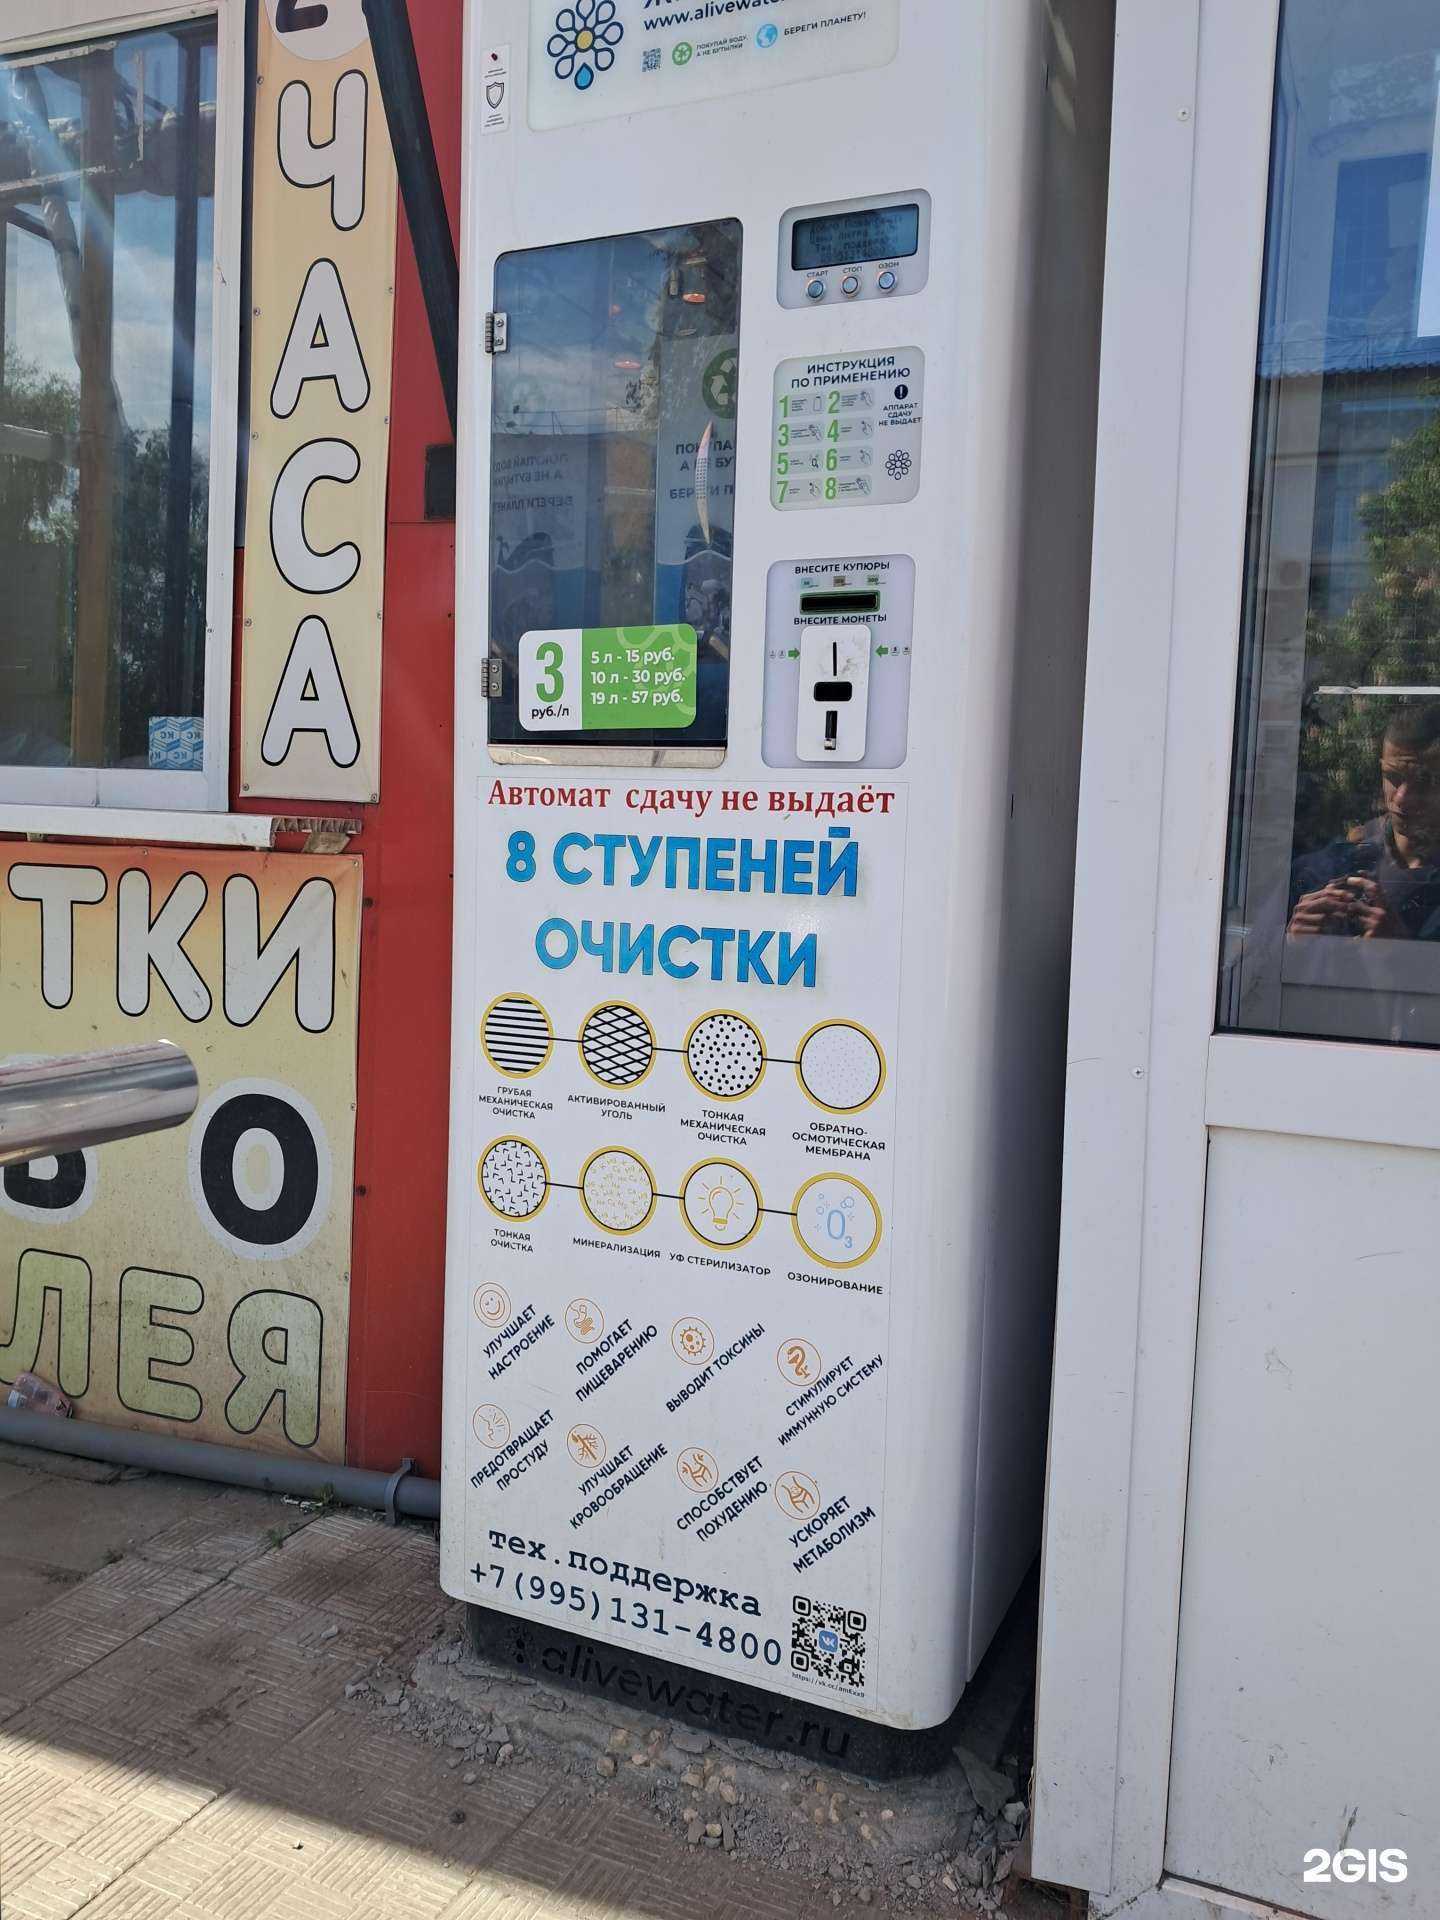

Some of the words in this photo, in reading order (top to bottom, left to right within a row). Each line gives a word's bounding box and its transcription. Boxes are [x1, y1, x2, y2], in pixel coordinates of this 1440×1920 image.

[643, 0, 784, 31] www.alivewate
[784, 22, 818, 36] БЕРЕГИ
[820, 12, 867, 28] ПЛАНЕТУ!
[807, 270, 829, 279] СТАРТ
[843, 266, 863, 274] СТОП
[879, 262, 900, 270] ОЗОН
[807, 356, 895, 374] ИНСТРУКЦИЯ
[792, 377, 810, 389] ПО
[814, 368, 911, 386] ПРИМЕНЕНИЮ
[779, 395, 789, 418] 1
[828, 390, 841, 414] 2
[883, 402, 919, 411] АППАРАТ
[261, 69, 370, 768] ЧАСА
[888, 411, 912, 419] СДАЧУ
[890, 417, 922, 426] ВЫДАЕТ
[778, 424, 789, 447] 3
[827, 419, 839, 443] 4
[777, 452, 789, 475] 5
[826, 448, 838, 472] 6
[776, 480, 789, 503] 7
[825, 477, 837, 500] 8
[795, 563, 840, 574] ВНЕСИТЕ
[843, 562, 890, 572] КУПЮРЫ
[794, 616, 839, 625] ВНЕСИТЕ
[840, 614, 887, 624] МОНЕТЫ
[591, 651, 600, 664] 5
[603, 654, 613, 663] л
[626, 650, 640, 663] 15
[644, 647, 675, 666] руб.
[536, 642, 565, 703] 3
[591, 671, 606, 684] 10
[610, 674, 619, 683] л
[632, 670, 650, 683] 30
[655, 668, 686, 686] руб.
[591, 692, 606, 705] 19
[609, 694, 619, 704] л
[631, 690, 648, 704] 57
[653, 688, 684, 706] руб.
[531, 704, 570, 719] руб./л
[487, 779, 611, 808] Автомат
[625, 786, 713, 818] сдачу
[721, 789, 759, 812] не
[768, 785, 895, 819] выдаёт
[505, 830, 537, 883] 8
[553, 826, 860, 898] СТУПЕНЕЙ
[8, 862, 337, 1034] ТКИ
[534, 917, 818, 988] ОЧИСТКИ
[496, 1085, 533, 1098] ГРУБАЯ
[478, 1095, 554, 1112] МЕХАНИЧЕСКАЯ
[492, 1108, 536, 1120] ОЧИСТКА
[567, 1094, 666, 1113] АКТИВИРОВАННЫЙ
[600, 1109, 634, 1121] УГОЛЬ
[701, 1109, 745, 1123] ТОНКАЯ
[680, 1119, 767, 1137] МЕХАНИЧЕСКАЯ
[697, 1132, 748, 1146] ОЧИСТКА
[809, 1122, 869, 1137] ОБРАТНО-
[791, 1132, 886, 1151] ОСМОТИЧЕСКАЯ
[805, 1144, 872, 1161] МЕМБРАНА
[490, 1239, 534, 1253] ОЧИСТКА
[493, 1228, 531, 1242] ТОНКАЯ
[572, 1237, 661, 1259] МИНЕРАЛИЗАЦИЯ
[669, 1252, 685, 1263] УФ
[687, 1255, 771, 1276] СТЕРИЛИЗАТОР
[787, 1271, 884, 1296] ОЗОНИРОВАНИЕ
[483, 1304, 537, 1359] УЛУЧШАЕТ
[488, 1314, 556, 1380] НАСТРОЕНИЕ
[575, 1318, 634, 1375] ПОМОГАЕТ
[575, 1324, 658, 1402] ПИЩЕВАРЕНИЮ
[666, 1364, 716, 1413] ВЫВОДИТ
[713, 1323, 766, 1371] ТОКСИНЫ
[785, 1355, 855, 1417] СТИМУЛИРУЕТ
[777, 1394, 837, 1446] ИММУННУЮ
[836, 1354, 885, 1398] СИСТЕМУ
[470, 1409, 556, 1489] ПРЕДОТВРАЩАЕТ
[496, 1440, 551, 1491] ПРОСТУДУ
[578, 1445, 635, 1496] УЛУЧШАЕТ
[569, 1442, 669, 1530] КРОВООБРАЩЕНИЕ
[676, 1455, 764, 1531] СПОСОБСТВУЕТ
[696, 1481, 769, 1542] ПОХУДЕНИЮ
[788, 1495, 851, 1548] УСКОРЯЕТ
[792, 1506, 877, 1574] МЕТАБОЛИЗМ
[488, 1529, 762, 1618] тех.поддержка
[469, 1562, 783, 1667] +7(995)131-4800
[541, 1637, 851, 1761] alivewater.ru
